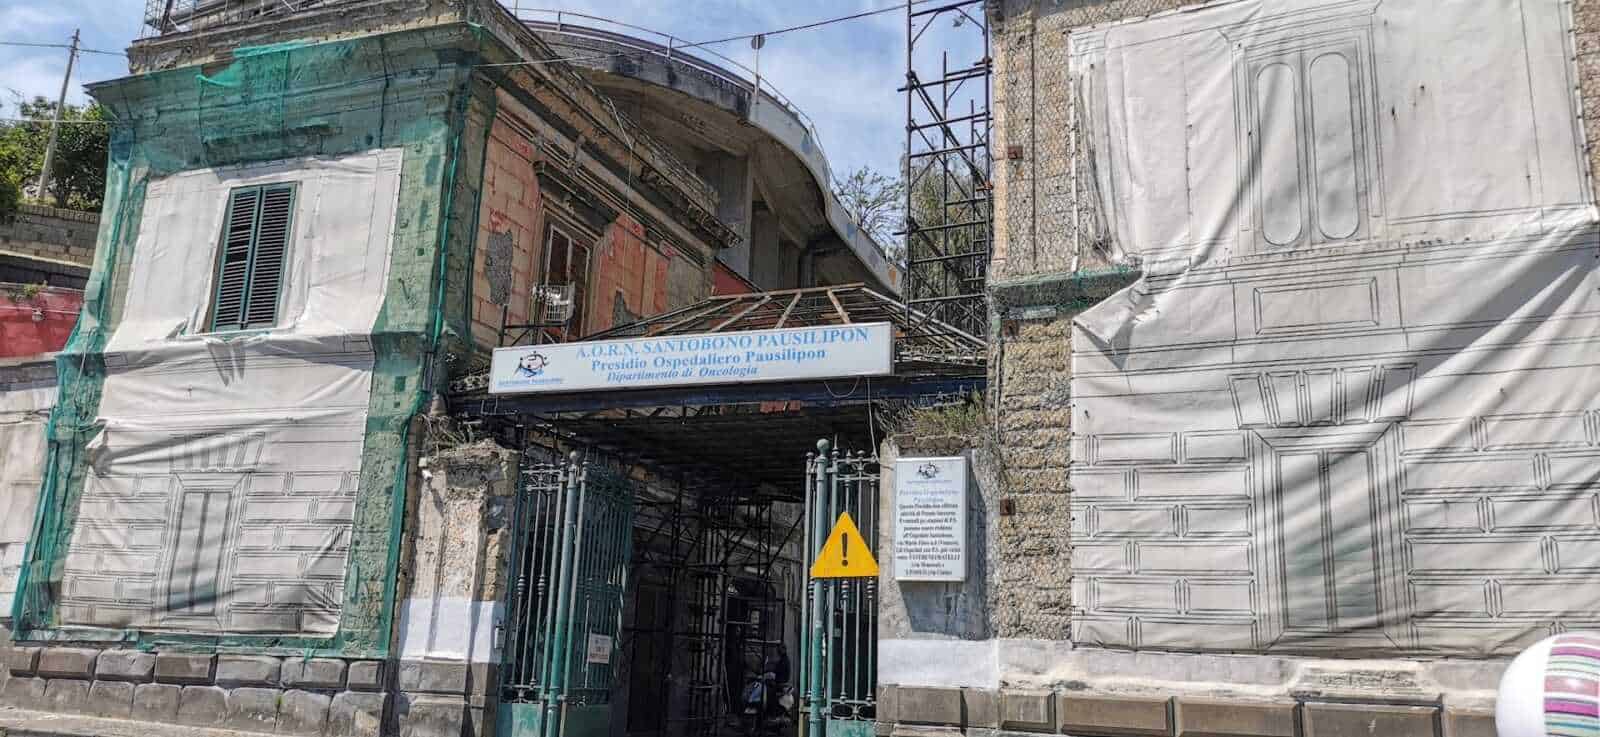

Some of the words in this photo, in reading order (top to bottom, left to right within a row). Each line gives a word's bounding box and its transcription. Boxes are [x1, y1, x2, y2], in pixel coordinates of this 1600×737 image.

[576, 343, 639, 360] A.O.R.N.
[642, 335, 752, 354] SANTOBONO
[757, 327, 869, 347] PAUSILIPON
[592, 357, 647, 372] Presidio
[653, 353, 740, 370] Ospedaliero
[746, 347, 827, 364] Pausilipon
[607, 370, 679, 384] Dipartimento
[682, 367, 693, 377] di
[699, 366, 758, 379] Oncologia
